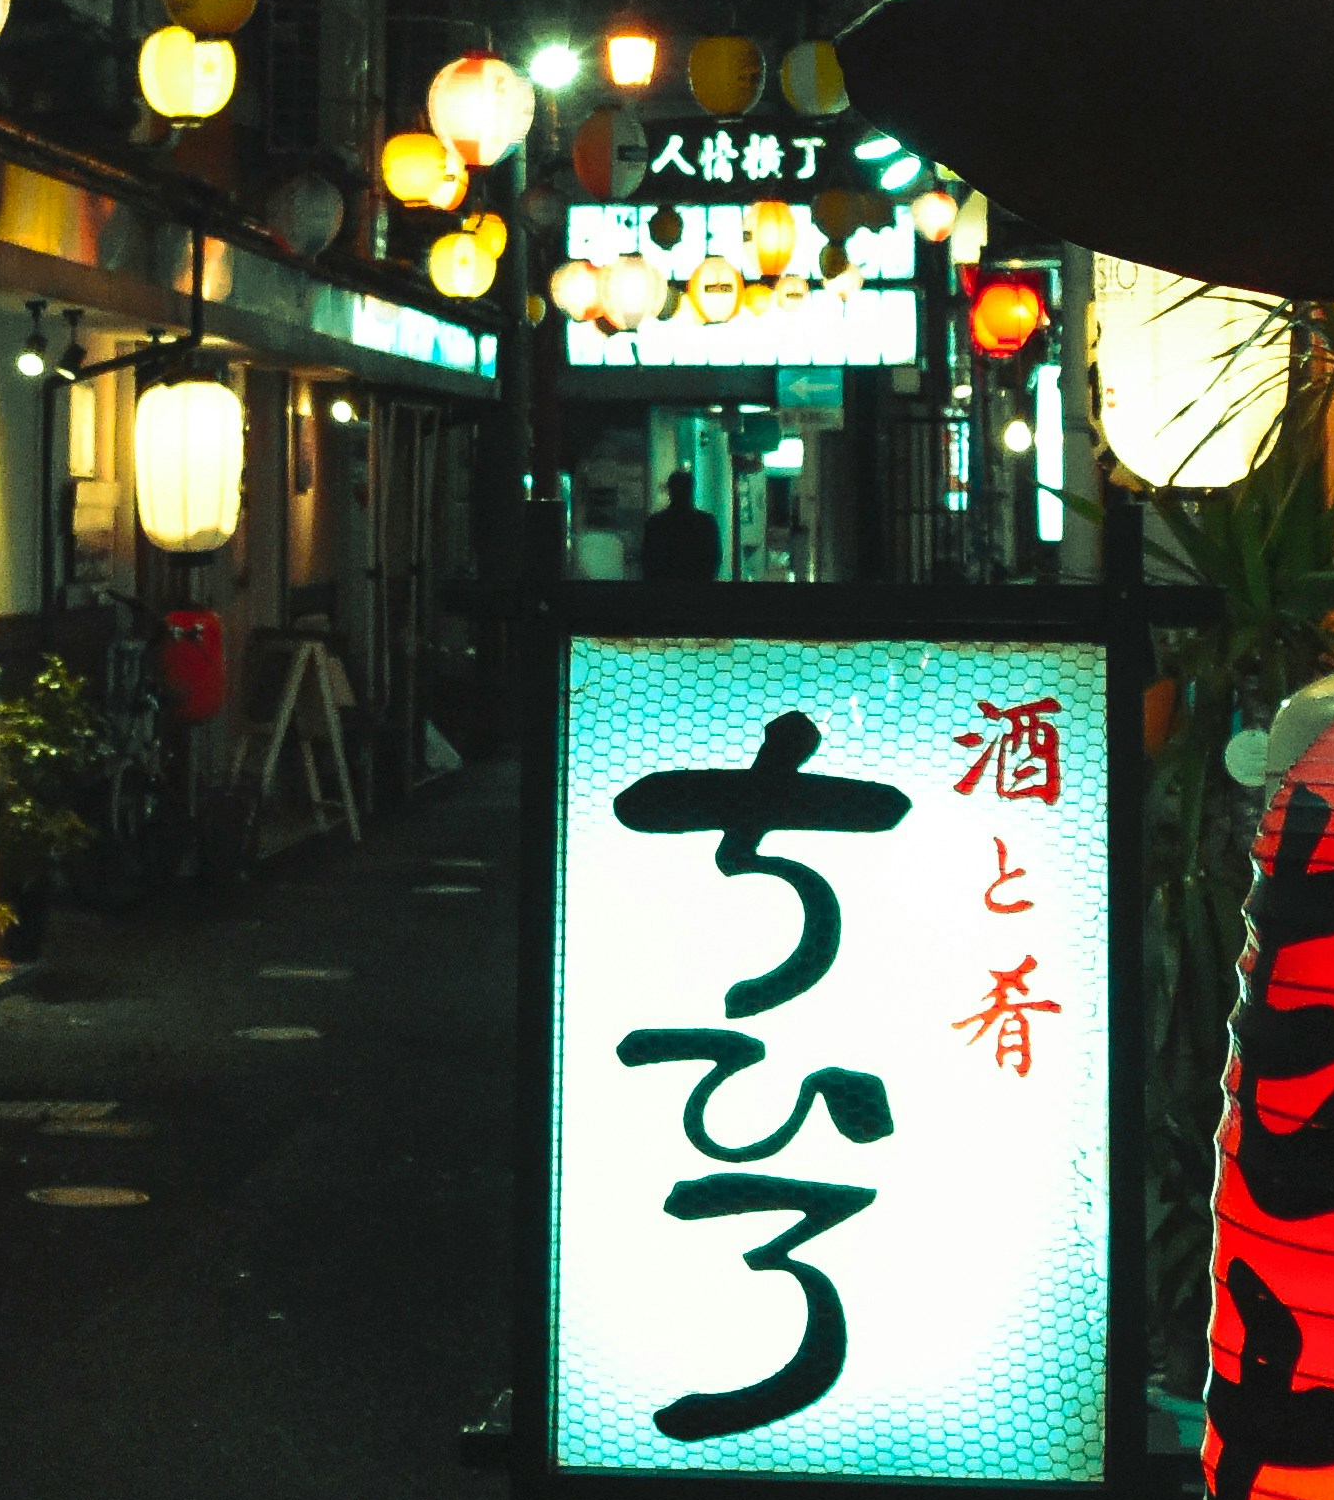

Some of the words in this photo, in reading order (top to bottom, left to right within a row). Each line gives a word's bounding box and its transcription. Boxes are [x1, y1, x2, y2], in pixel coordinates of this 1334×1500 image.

[612, 709, 914, 1445] ちひろ
[951, 696, 1064, 1079] 酒と肴
